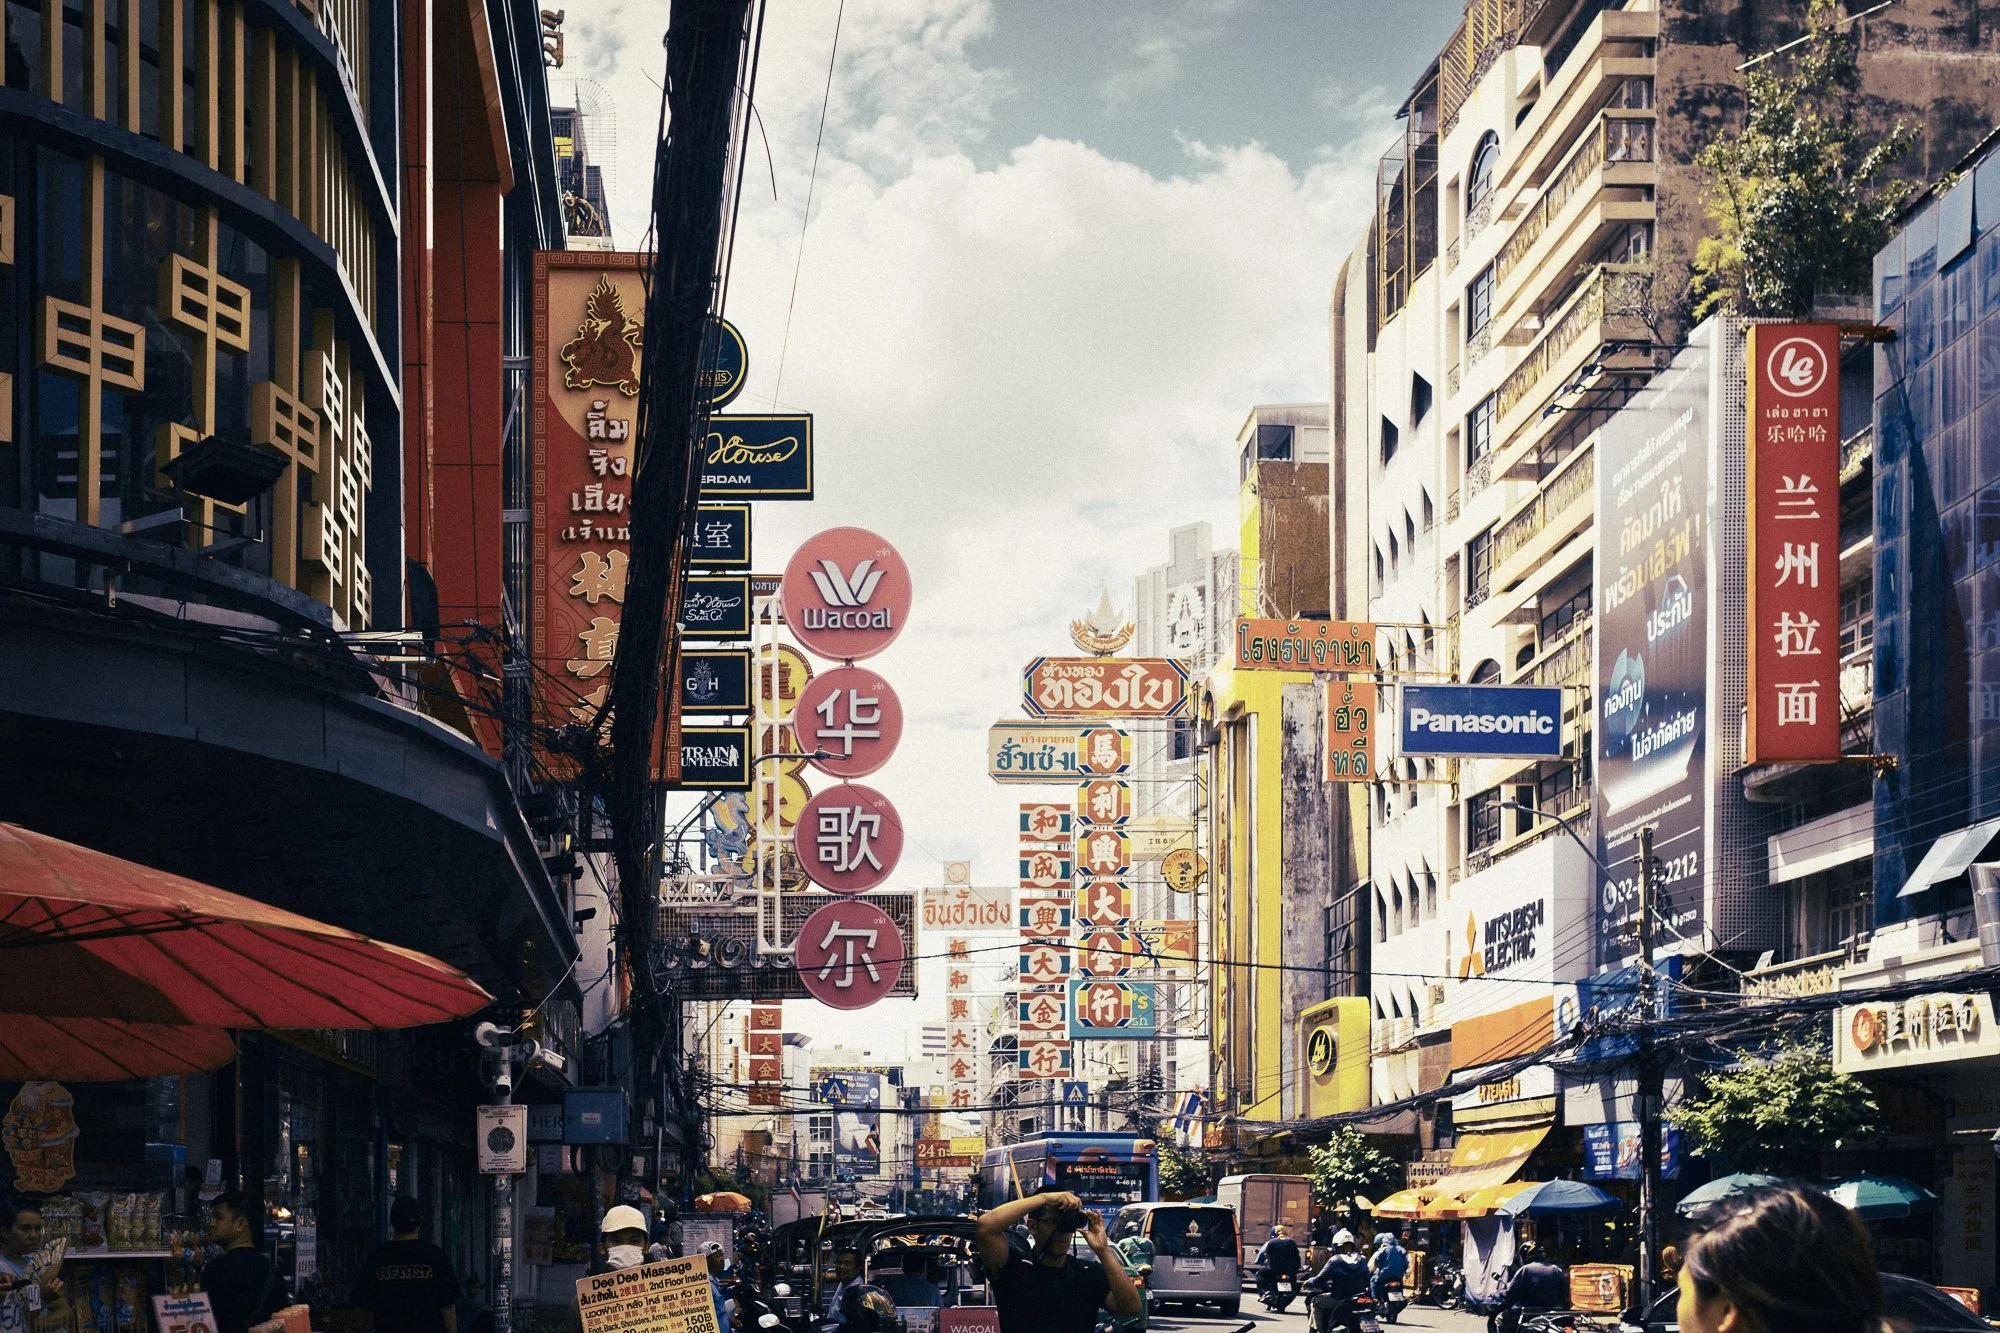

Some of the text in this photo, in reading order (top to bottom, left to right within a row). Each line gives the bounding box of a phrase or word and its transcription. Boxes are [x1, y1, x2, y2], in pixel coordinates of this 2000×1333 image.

[1766, 424, 1828, 444] 乐哈哈
[701, 475, 751, 484] ERDAM
[1773, 474, 1822, 727] 兰州拉面
[803, 608, 893, 630] Wacoal
[1646, 589, 1693, 644] ประกัน
[1238, 623, 1373, 667] โรงรับจำนำ
[1038, 663, 1174, 709] ทองใบ
[1409, 707, 1554, 735] Panasonic
[1020, 732, 1076, 744] ห้างขายทอ
[681, 757, 730, 767] UNTERS
[996, 737, 1076, 772] ฮั่วเซ่งเ
[1484, 898, 1544, 945] MITSUBISHI
[1032, 809, 1058, 1073] 和成興大金行
[1484, 930, 1536, 974] ELECTRIC
[592, 1261, 692, 1291] Dee Dee Massage
[649, 1279, 664, 1291] 2nd
[665, 1277, 685, 1288] Floor
[684, 1272, 708, 1284] Inside
[669, 1310, 685, 1318] Neck
[684, 1304, 710, 1315] Massage
[950, 1325, 995, 1333] WACOAL
